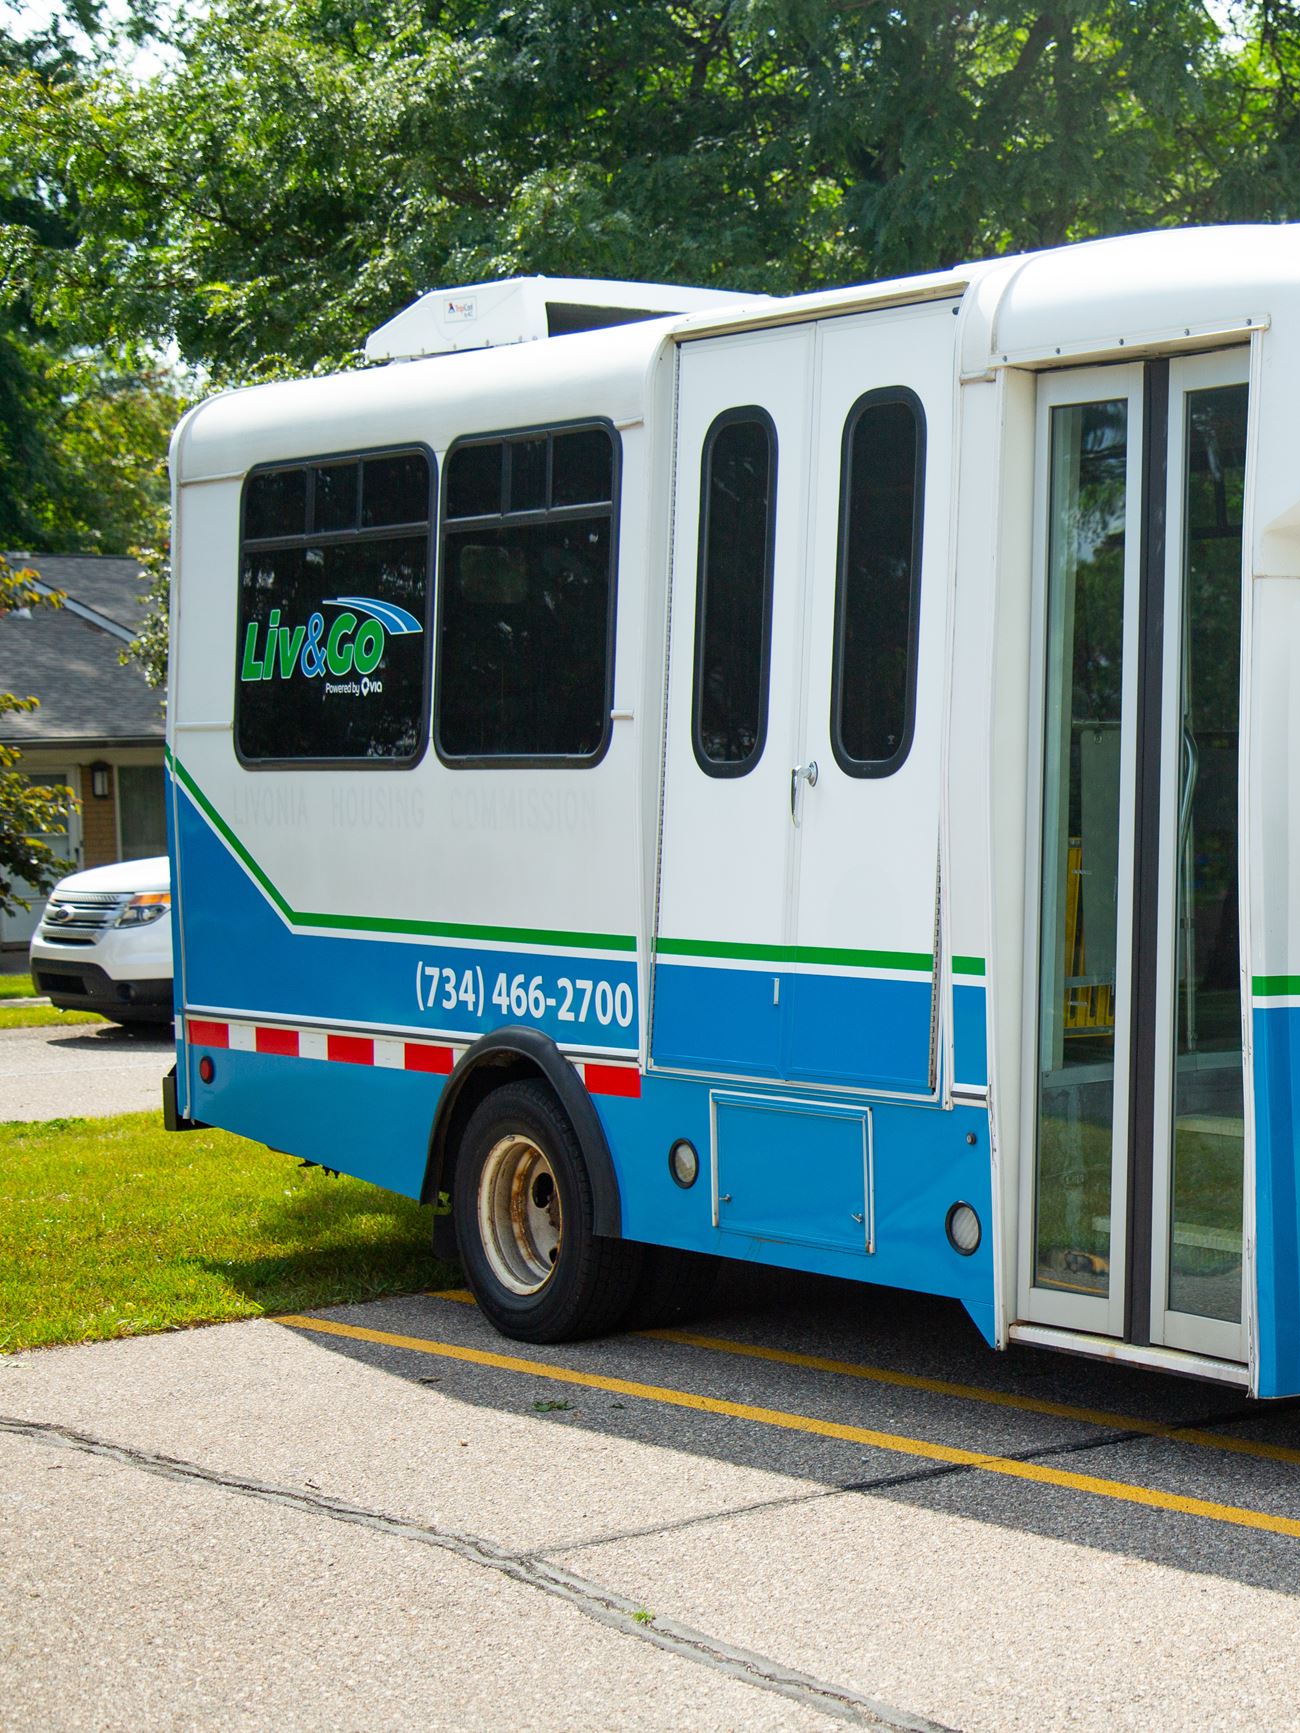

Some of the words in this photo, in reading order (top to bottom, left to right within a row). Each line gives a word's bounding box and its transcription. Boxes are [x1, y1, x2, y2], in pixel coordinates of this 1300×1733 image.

[241, 609, 385, 681] Liv&Go
[325, 682, 351, 694] Powered
[352, 681, 360, 696] by
[233, 786, 309, 827] LIVONIA
[331, 787, 425, 831] HOUSING
[448, 787, 597, 833] COMMISSION
[416, 960, 484, 1017] (734)
[492, 972, 634, 1027] 466-2700
